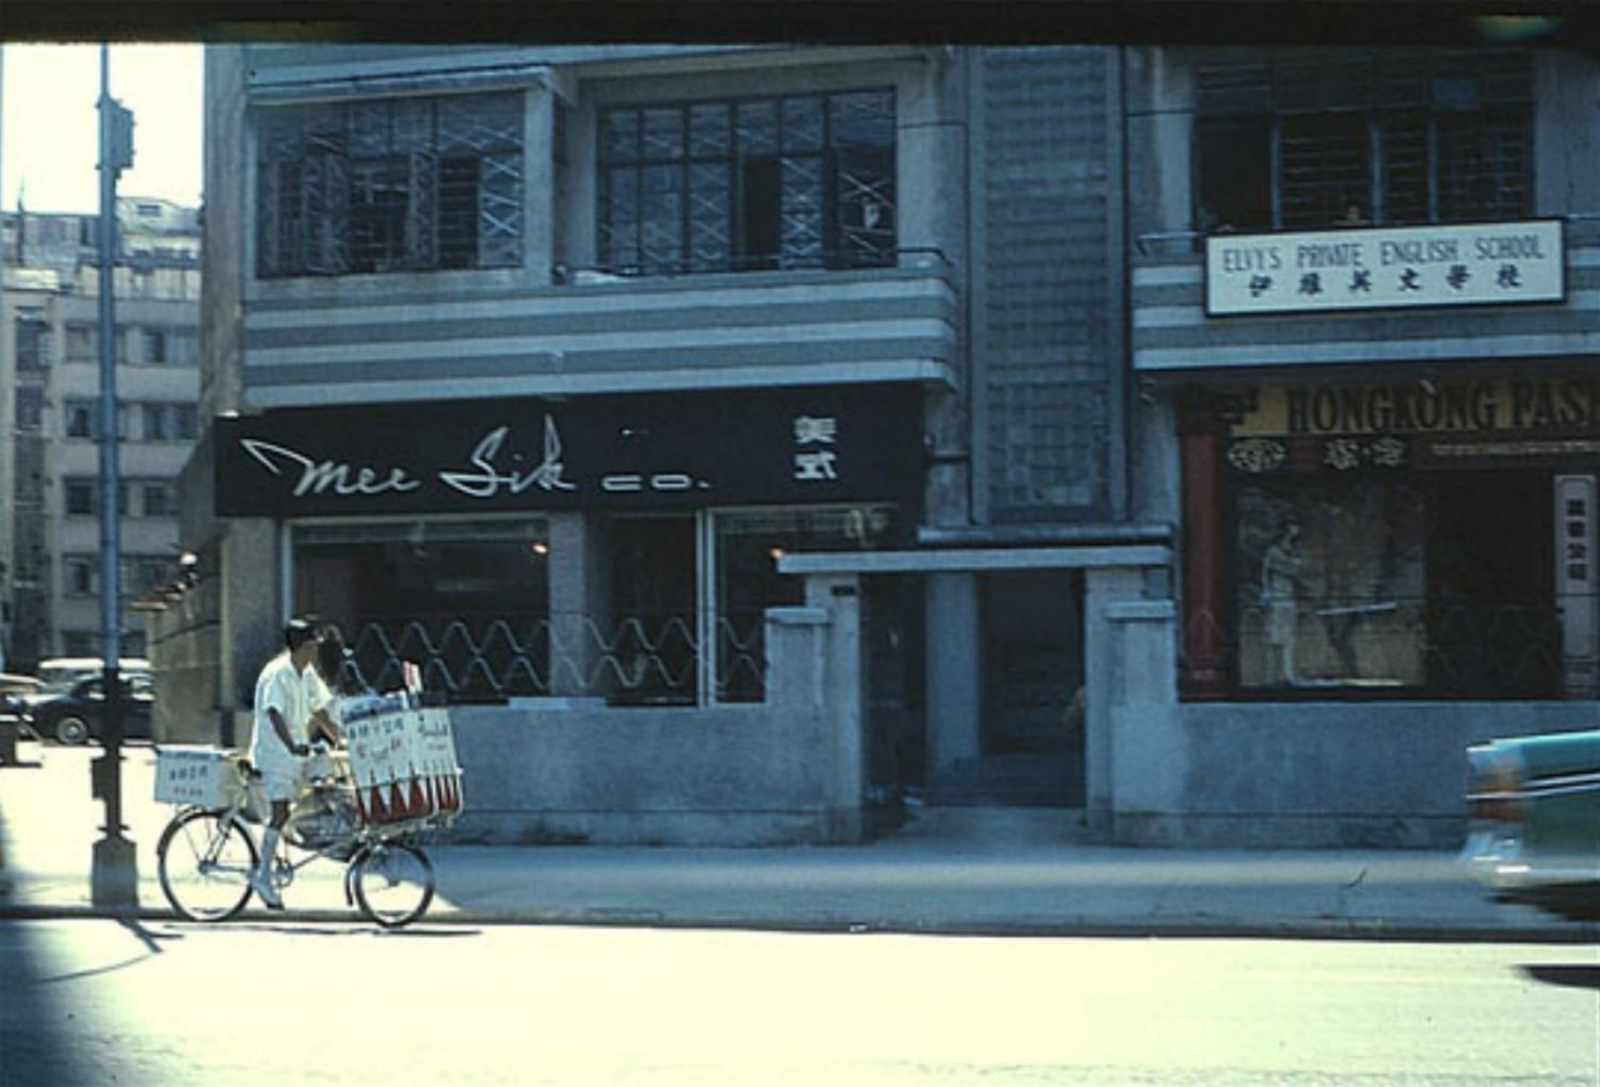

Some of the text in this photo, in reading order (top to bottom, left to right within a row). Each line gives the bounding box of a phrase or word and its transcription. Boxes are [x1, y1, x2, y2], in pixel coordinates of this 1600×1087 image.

[1223, 235, 1545, 272] ELVY'S PRIVATE ENGLISH SCHOOL
[1288, 383, 1498, 433] HONGKONG
[241, 438, 421, 497] Mee
[439, 413, 576, 497] Sik
